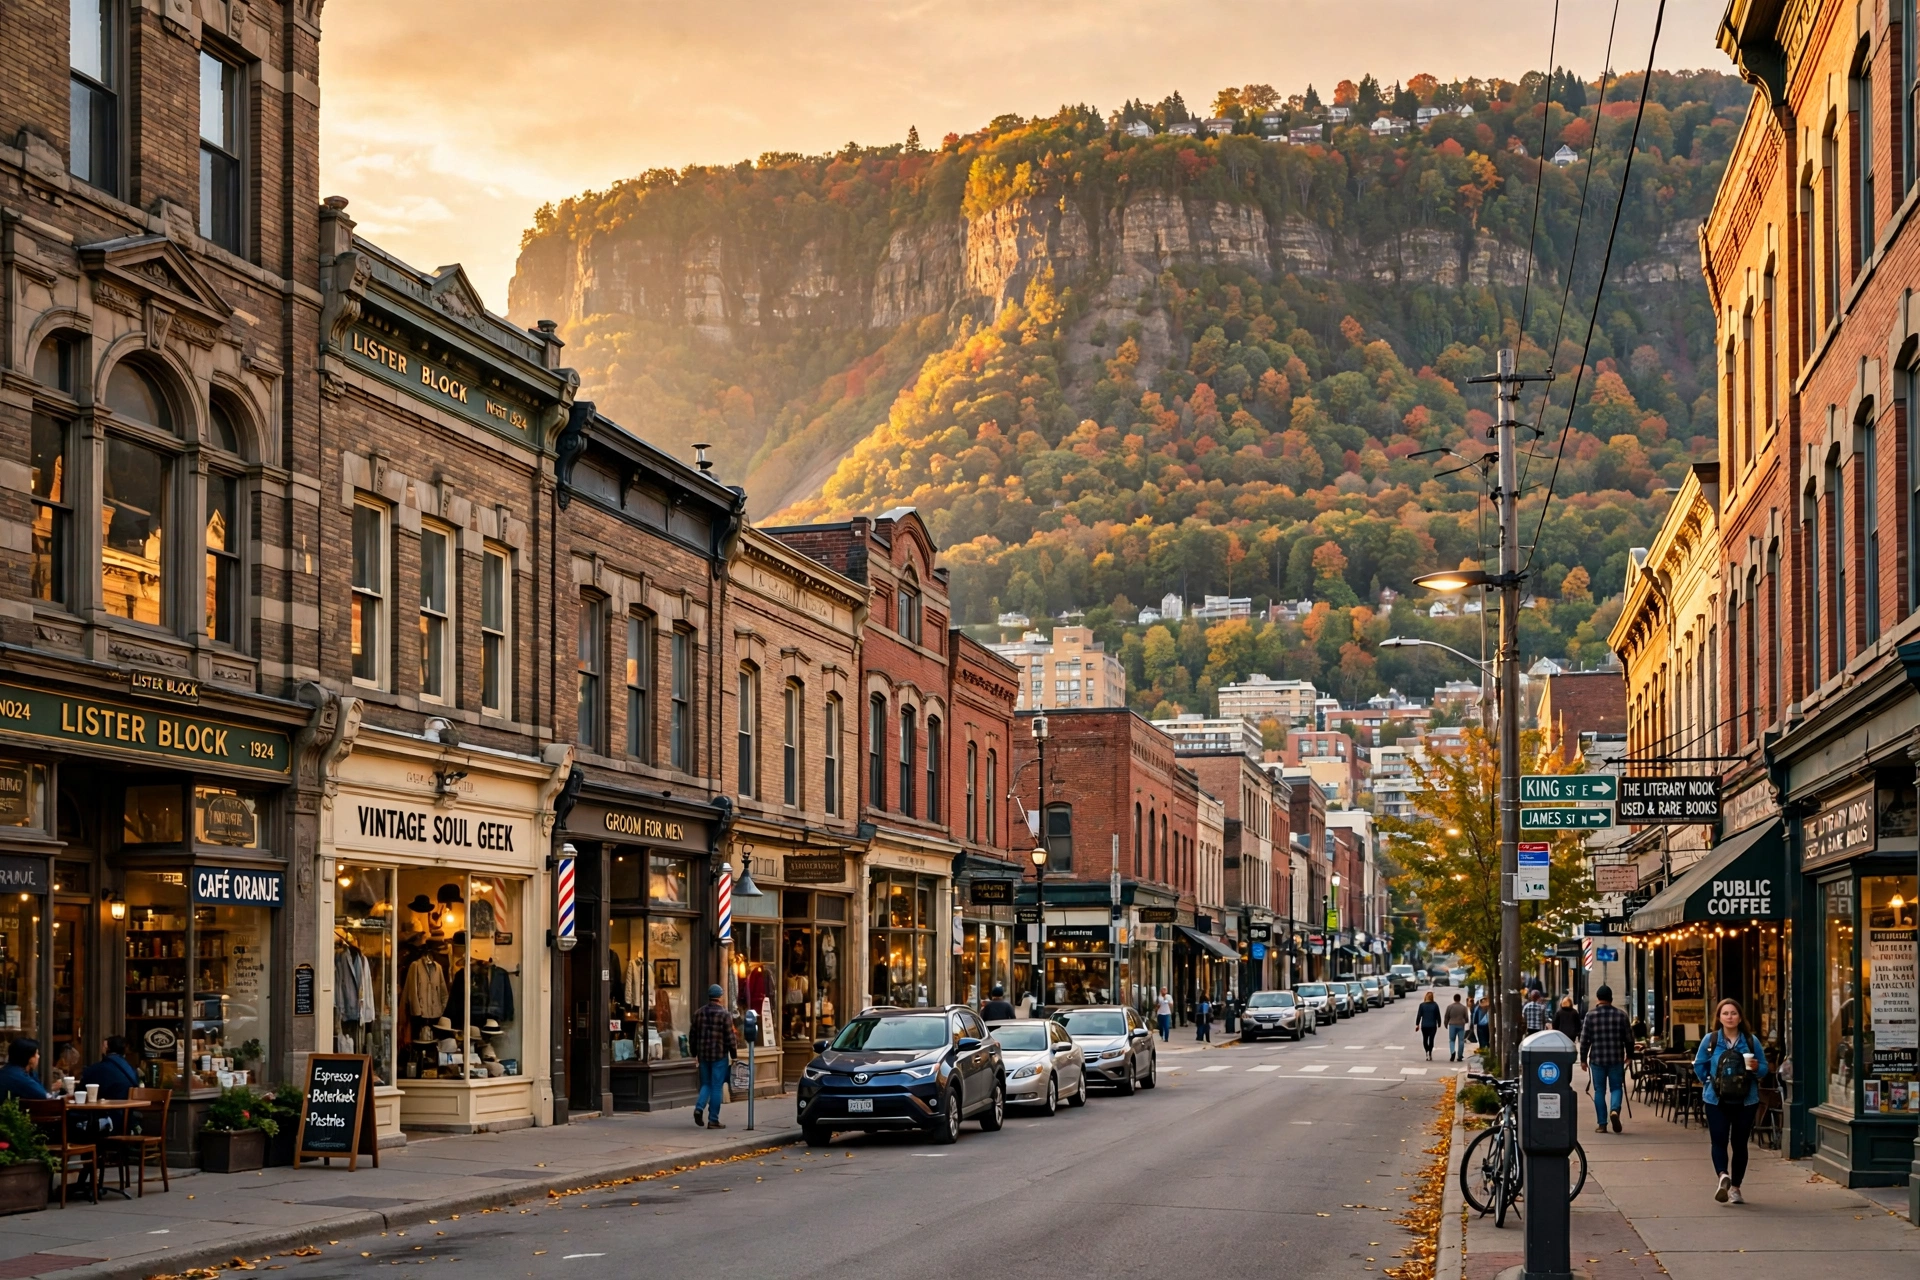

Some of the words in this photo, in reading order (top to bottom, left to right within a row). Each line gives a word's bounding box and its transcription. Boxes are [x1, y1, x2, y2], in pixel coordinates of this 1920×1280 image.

[353, 332, 407, 375] LISTER
[421, 365, 468, 404] BLOCK
[132, 673, 163, 690] LISTER
[62, 703, 146, 743] LISTER
[158, 719, 229, 756] BLOCK
[250, 741, 275, 760] 1924
[1526, 779, 1560, 797] KING
[1565, 784, 1577, 796] ST
[1582, 784, 1589, 796] E
[1622, 782, 1640, 797] THE
[1643, 781, 1687, 797] LITERARY
[1689, 781, 1715, 796] NOOK
[1621, 801, 1645, 816] USED
[1647, 801, 1655, 815] &
[1658, 801, 1682, 815] RARE
[1686, 801, 1718, 815] BOOKS
[605, 812, 641, 835] GROOM
[644, 819, 663, 838] FOR
[665, 822, 684, 840] MEN
[1525, 811, 1561, 825] JAMES
[1565, 814, 1575, 825] ST
[357, 805, 427, 842] VINTAGE
[432, 815, 472, 847] SOUL
[477, 821, 514, 852] GEEK
[198, 869, 230, 899] CAFÉ
[233, 875, 280, 901] ORANJE
[1713, 879, 1771, 897] PUBLIC
[1707, 898, 1771, 915] COFFEE
[314, 1067, 353, 1086] Espresso
[310, 1111, 345, 1128] Pastries
